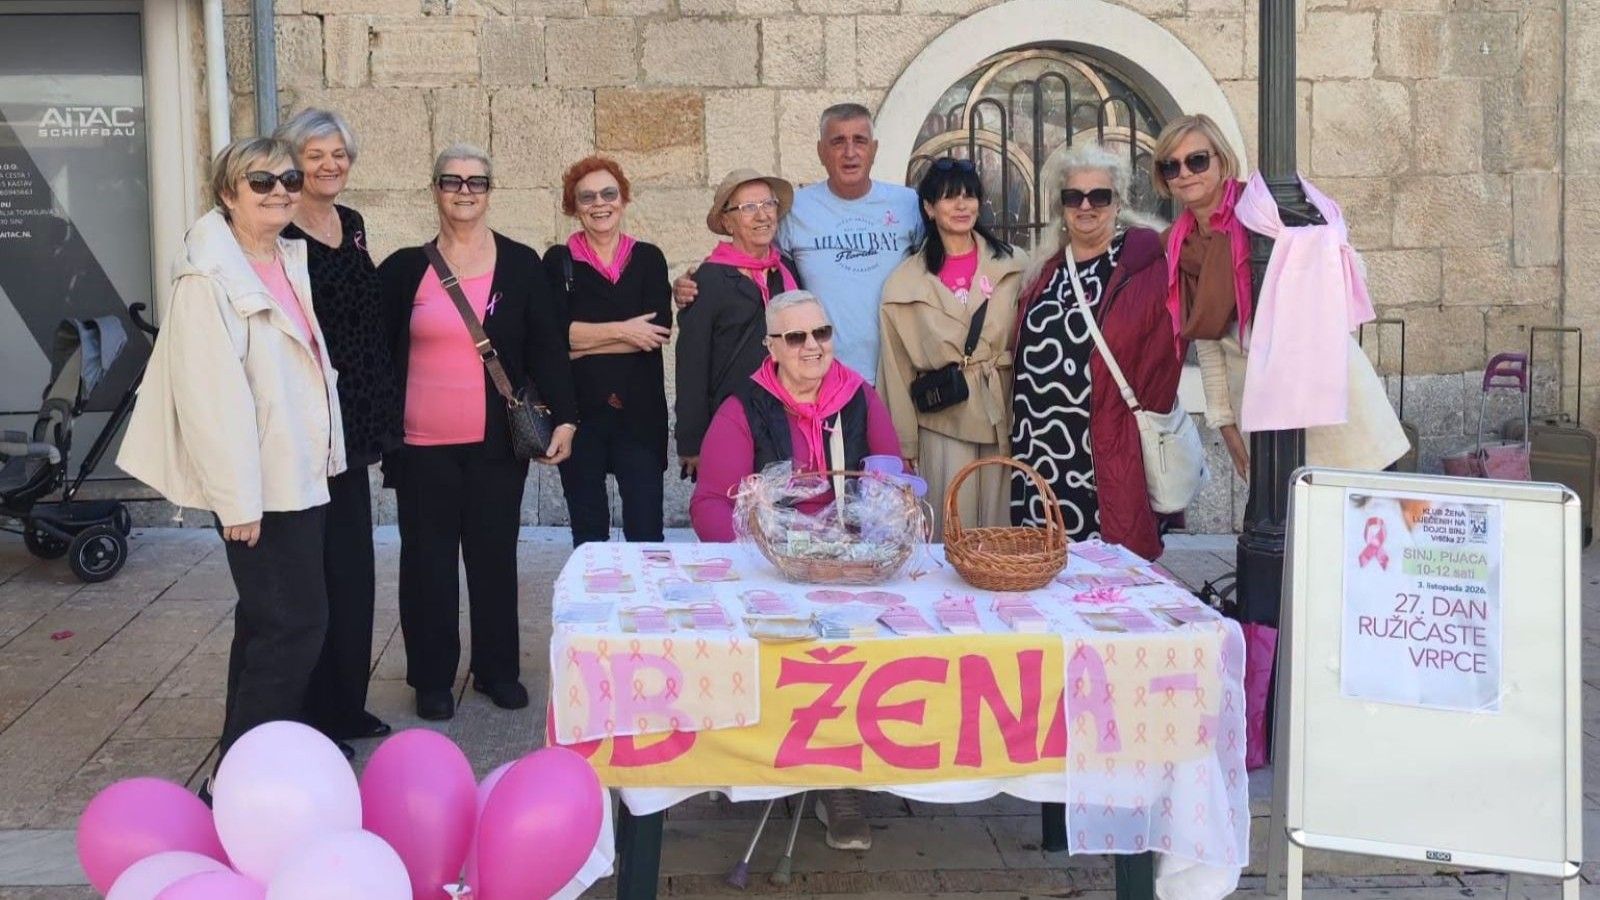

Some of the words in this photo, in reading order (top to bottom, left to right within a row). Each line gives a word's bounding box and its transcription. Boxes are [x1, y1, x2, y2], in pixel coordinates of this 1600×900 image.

[38, 128, 136, 137] SCHIFFBAU
[814, 233, 864, 250] MIAMI
[867, 232, 899, 251] BAY
[834, 249, 878, 263] Florida
[1423, 507, 1443, 516] KLUB
[1445, 508, 1466, 517] ŽENA
[1454, 518, 1466, 526] NA
[1423, 525, 1447, 533] DOJCI
[1448, 527, 1466, 535] SINJ
[1439, 551, 1487, 565] PIJACA
[1416, 564, 1450, 577] 10-12
[1453, 568, 1475, 579] sati
[1427, 582, 1462, 592] listopada
[1395, 593, 1425, 615] 27.
[1432, 596, 1487, 620] DAN
[1358, 614, 1487, 647] RUŽIČASTE
[1408, 646, 1487, 674] VRPCE
[773, 645, 1122, 773] ŽENA
